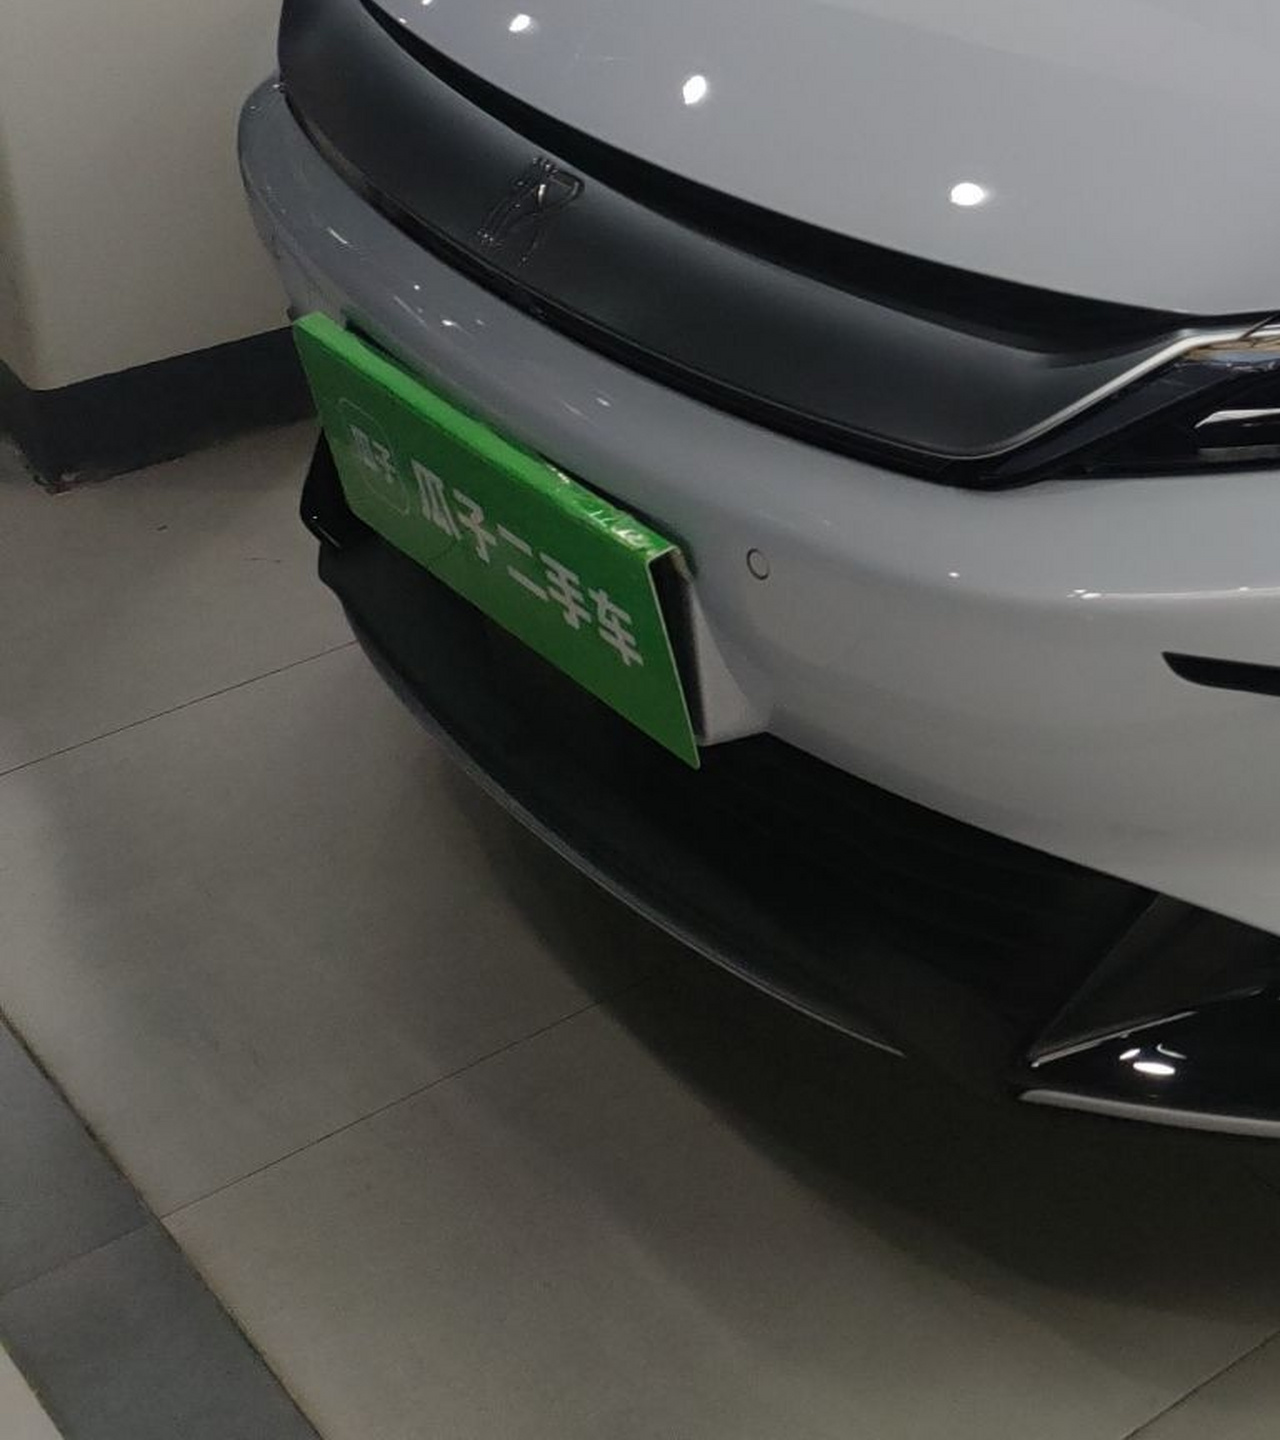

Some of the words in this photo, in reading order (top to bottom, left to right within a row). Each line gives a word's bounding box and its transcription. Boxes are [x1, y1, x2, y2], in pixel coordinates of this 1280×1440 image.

[411, 459, 644, 667] 瓜子二手车
